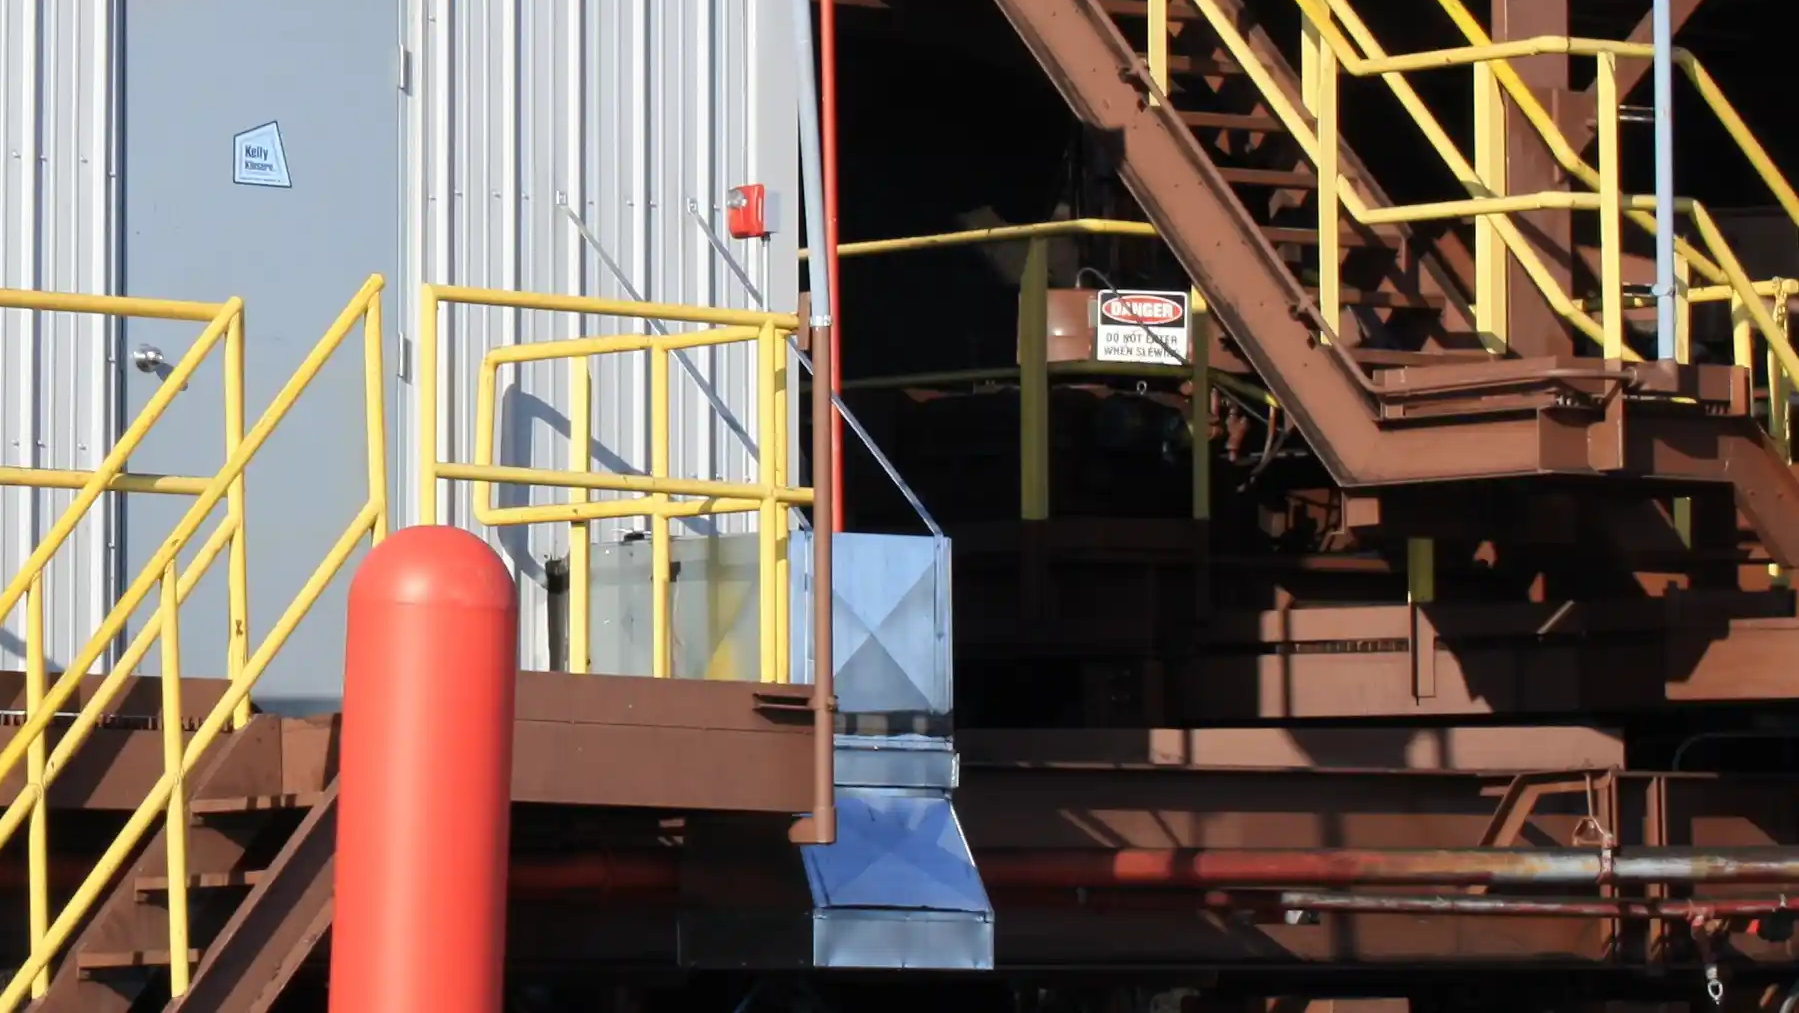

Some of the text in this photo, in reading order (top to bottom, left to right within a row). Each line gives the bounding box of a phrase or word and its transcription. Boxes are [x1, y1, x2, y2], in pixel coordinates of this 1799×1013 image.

[245, 145, 269, 161] Kelly
[1110, 301, 1174, 318] DANGER
[1106, 333, 1119, 343] DO
[1123, 333, 1142, 344] NOT
[1104, 346, 1181, 359] WHEN SLEWI
